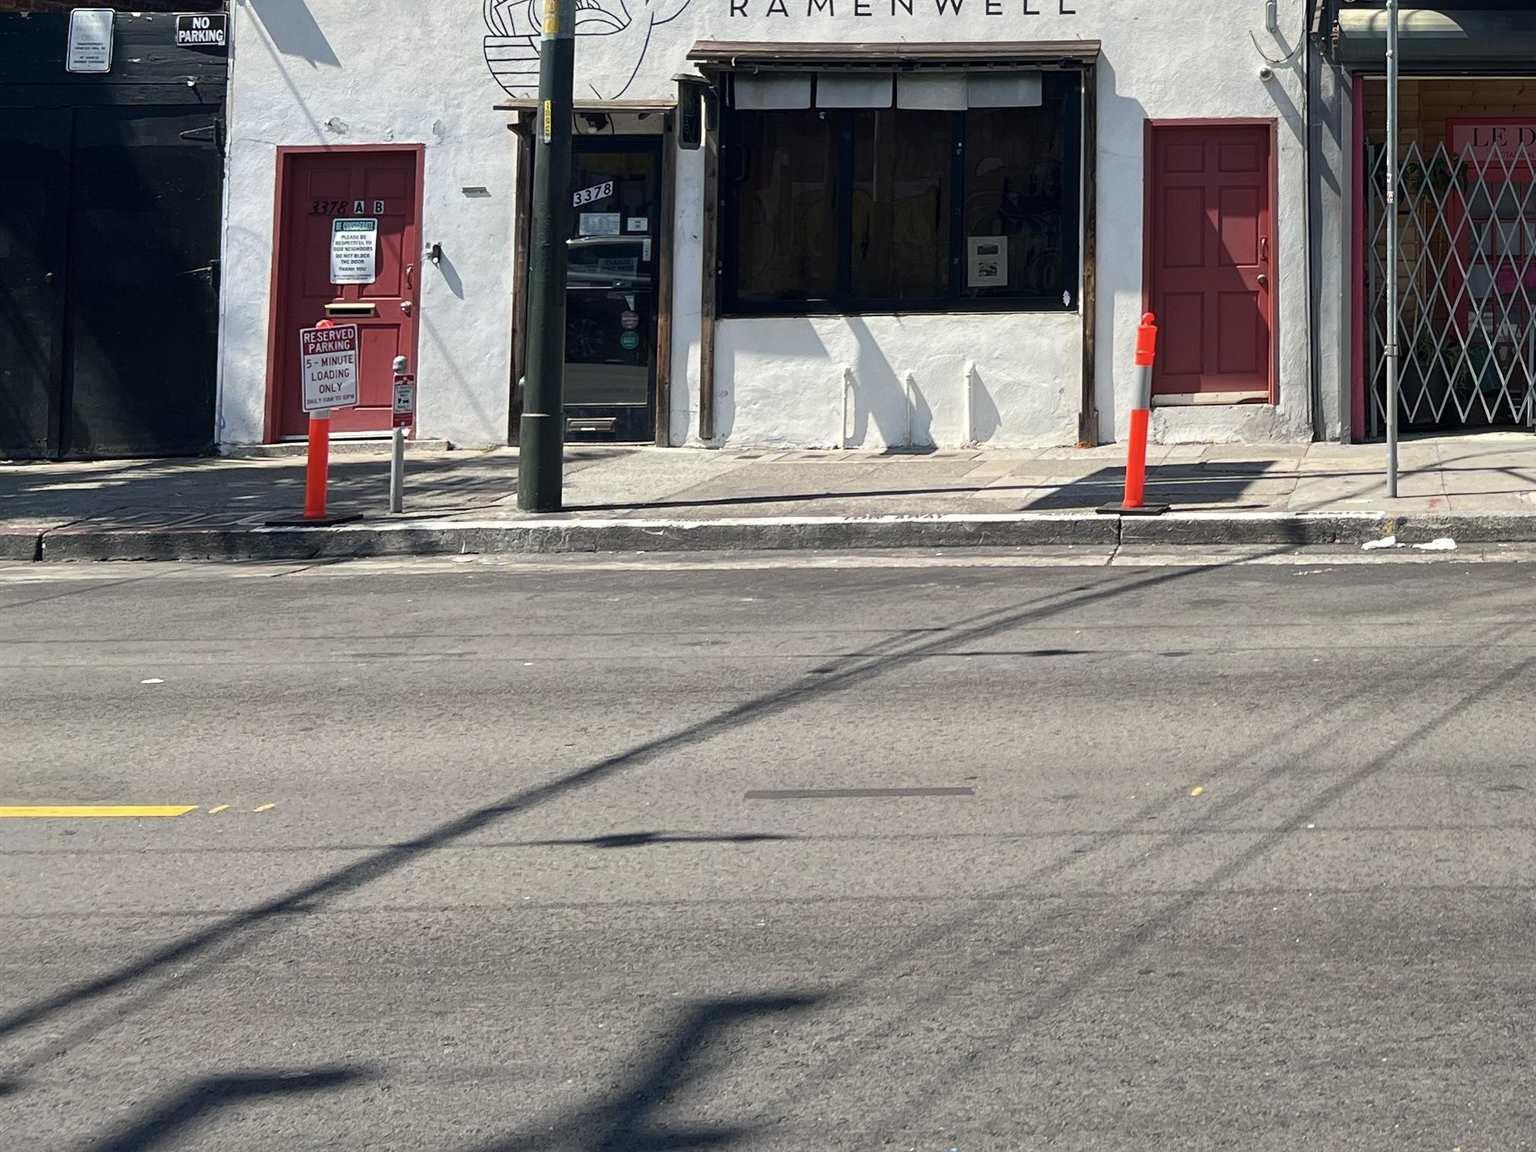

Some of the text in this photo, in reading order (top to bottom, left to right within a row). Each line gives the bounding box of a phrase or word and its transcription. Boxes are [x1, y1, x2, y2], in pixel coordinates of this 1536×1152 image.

[192, 16, 210, 29] NO
[178, 29, 224, 43] PARKING
[1473, 126, 1507, 147] LE
[574, 182, 612, 205] 3378
[355, 201, 363, 213] A
[375, 201, 383, 213] B
[303, 328, 354, 343] RESERVED
[309, 340, 350, 353] PARKING
[306, 359, 312, 368] 5
[321, 354, 354, 367] MINUTE
[311, 368, 349, 382] LOADING
[319, 382, 343, 394] ONLY
